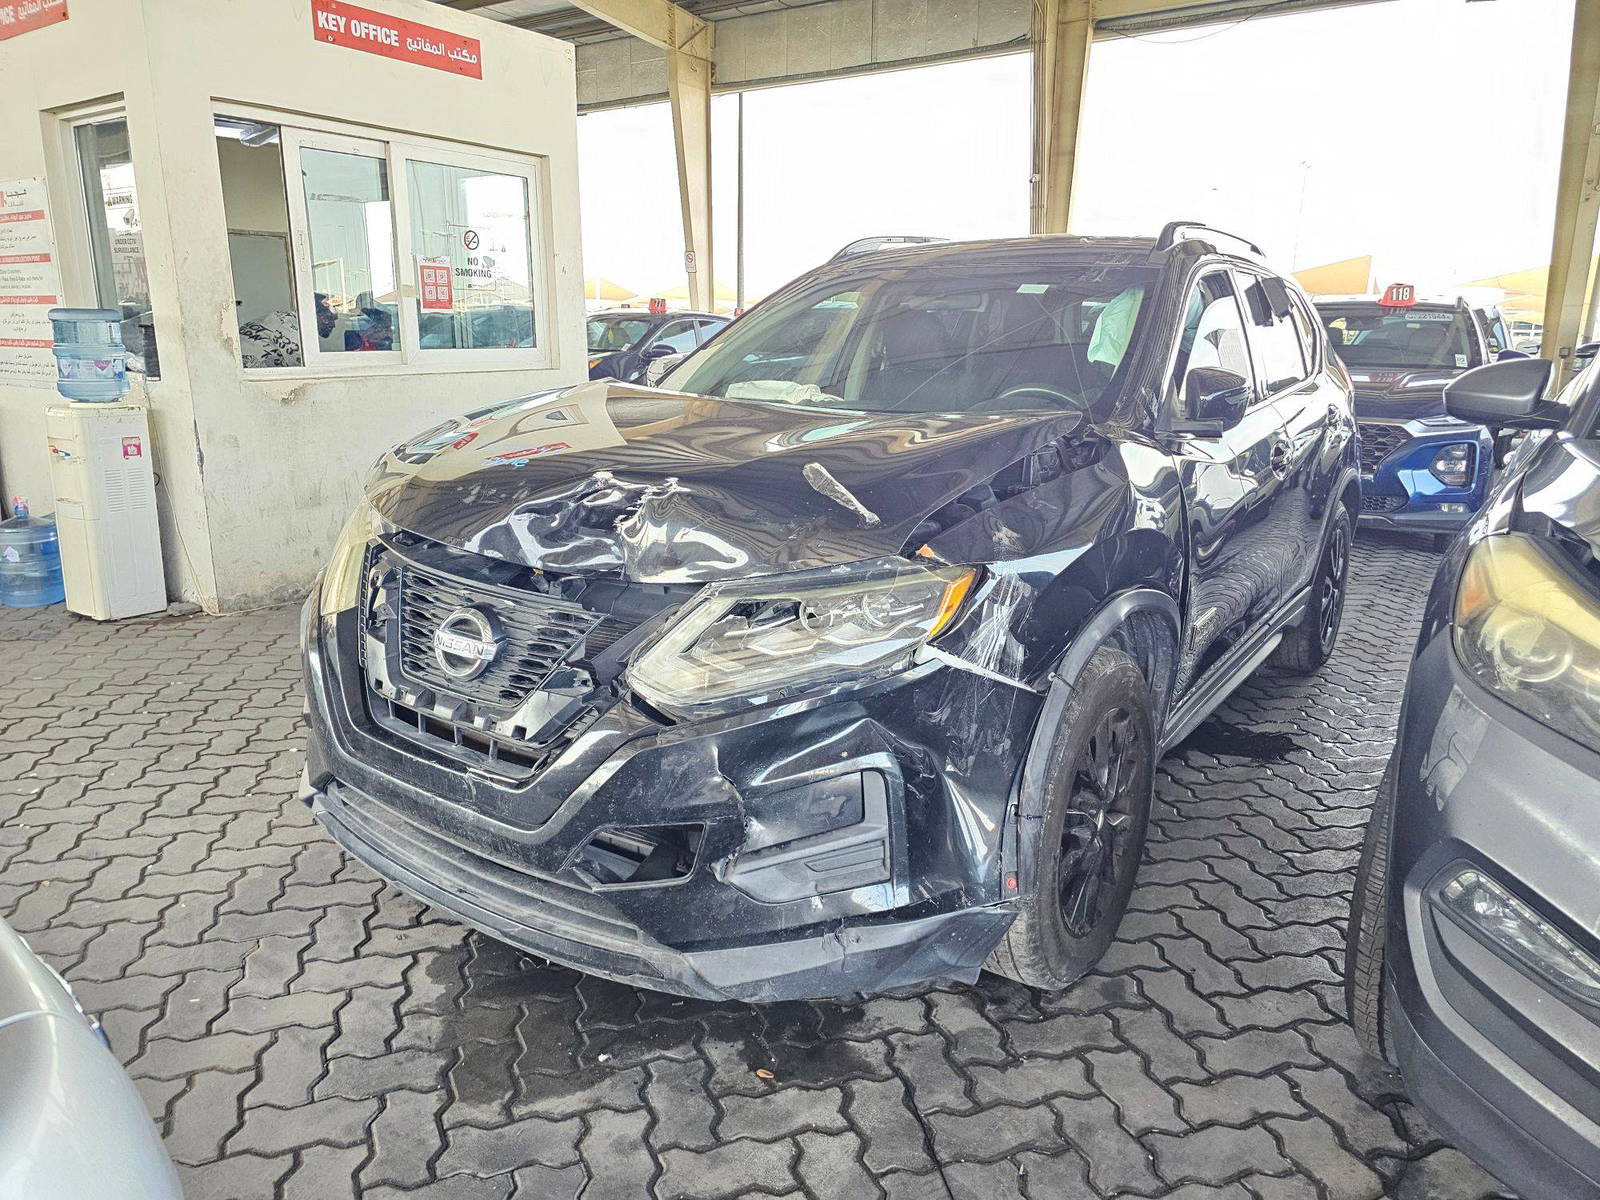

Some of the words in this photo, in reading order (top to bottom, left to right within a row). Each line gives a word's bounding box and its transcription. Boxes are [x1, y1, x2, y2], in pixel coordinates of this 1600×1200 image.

[317, 10, 347, 34] KEY
[350, 19, 400, 48] OFFICE
[405, 36, 446, 57] المفاتيح
[448, 46, 478, 65] مكتب
[467, 256, 479, 267] NO
[455, 266, 492, 279] SMOKING
[1391, 287, 1410, 301] 118
[434, 631, 486, 656] NISSAN
